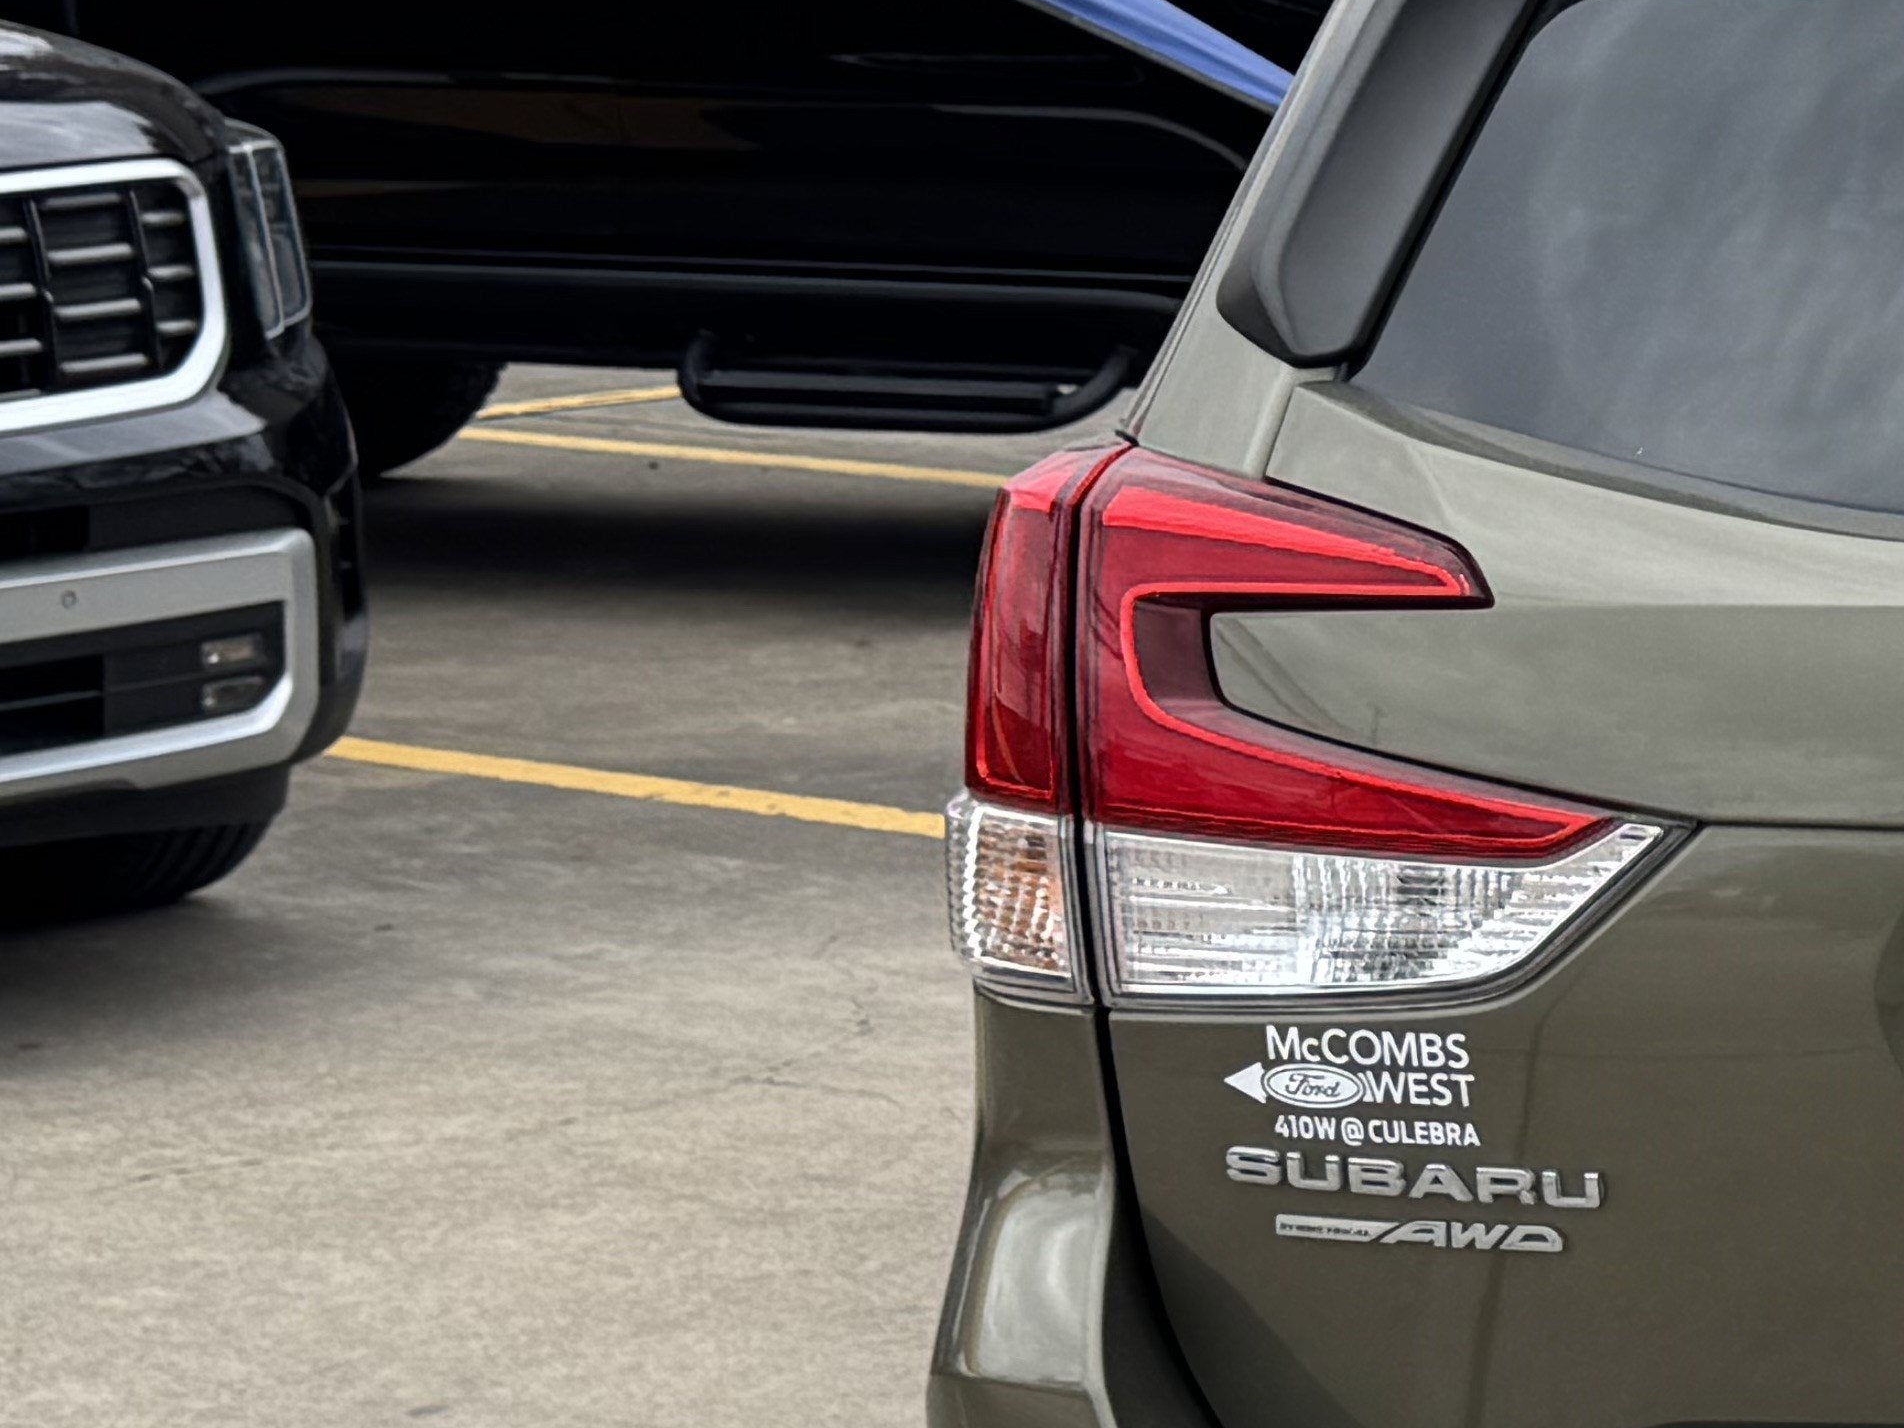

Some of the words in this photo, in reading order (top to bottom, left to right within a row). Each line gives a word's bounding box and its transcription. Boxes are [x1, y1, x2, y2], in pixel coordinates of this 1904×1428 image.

[1265, 1024, 1470, 1070] McCOMBS
[1285, 1073, 1341, 1098] Ford
[1366, 1070, 1476, 1108] WEST
[1274, 1114, 1337, 1141] 410W
[1367, 1119, 1482, 1147] CULEBRA
[1226, 1144, 1603, 1209] SUBARU
[1379, 1220, 1563, 1253] AWD
